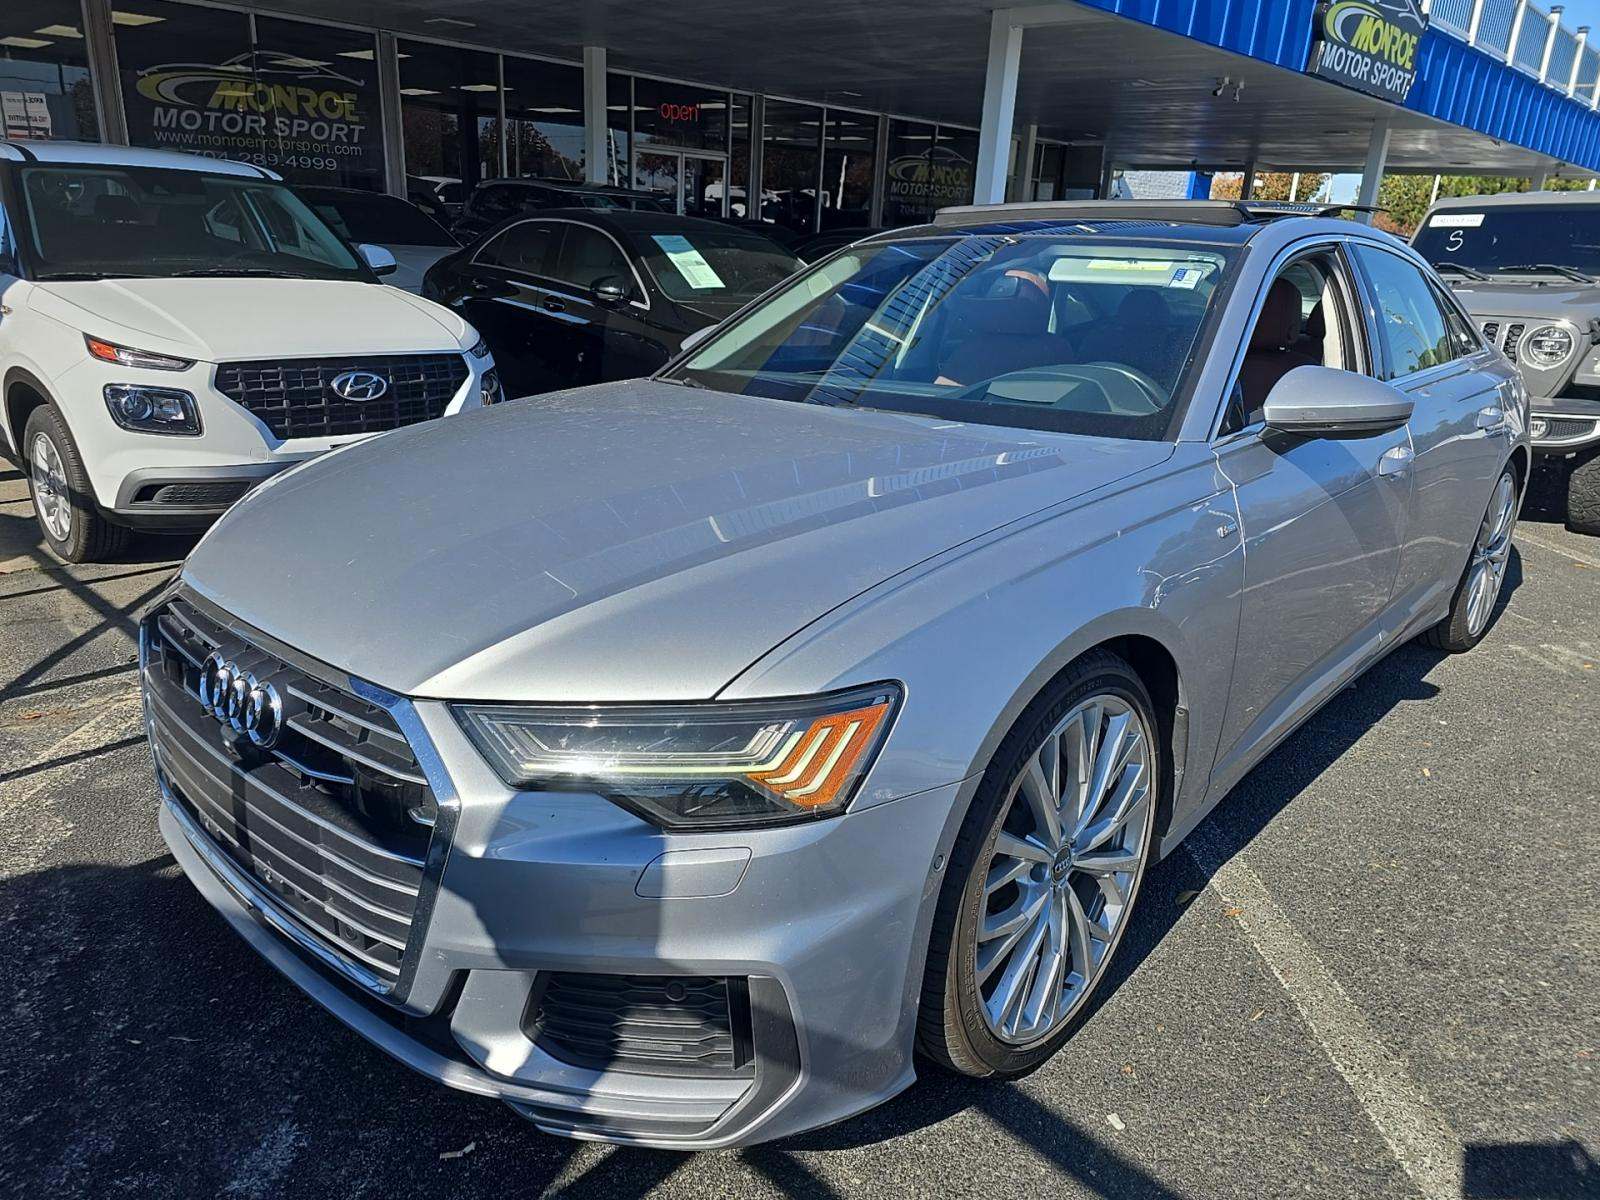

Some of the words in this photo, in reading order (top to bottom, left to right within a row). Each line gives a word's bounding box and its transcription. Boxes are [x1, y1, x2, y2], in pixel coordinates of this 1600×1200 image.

[1351, 15, 1418, 70] MONROE
[1321, 42, 1371, 81] MOTOR
[1371, 61, 1412, 95] SPORT
[206, 79, 360, 122] MONROE
[661, 103, 698, 125] open
[153, 107, 266, 136] MOTOR
[274, 117, 366, 144] SPORT
[1446, 230, 1464, 251] S
